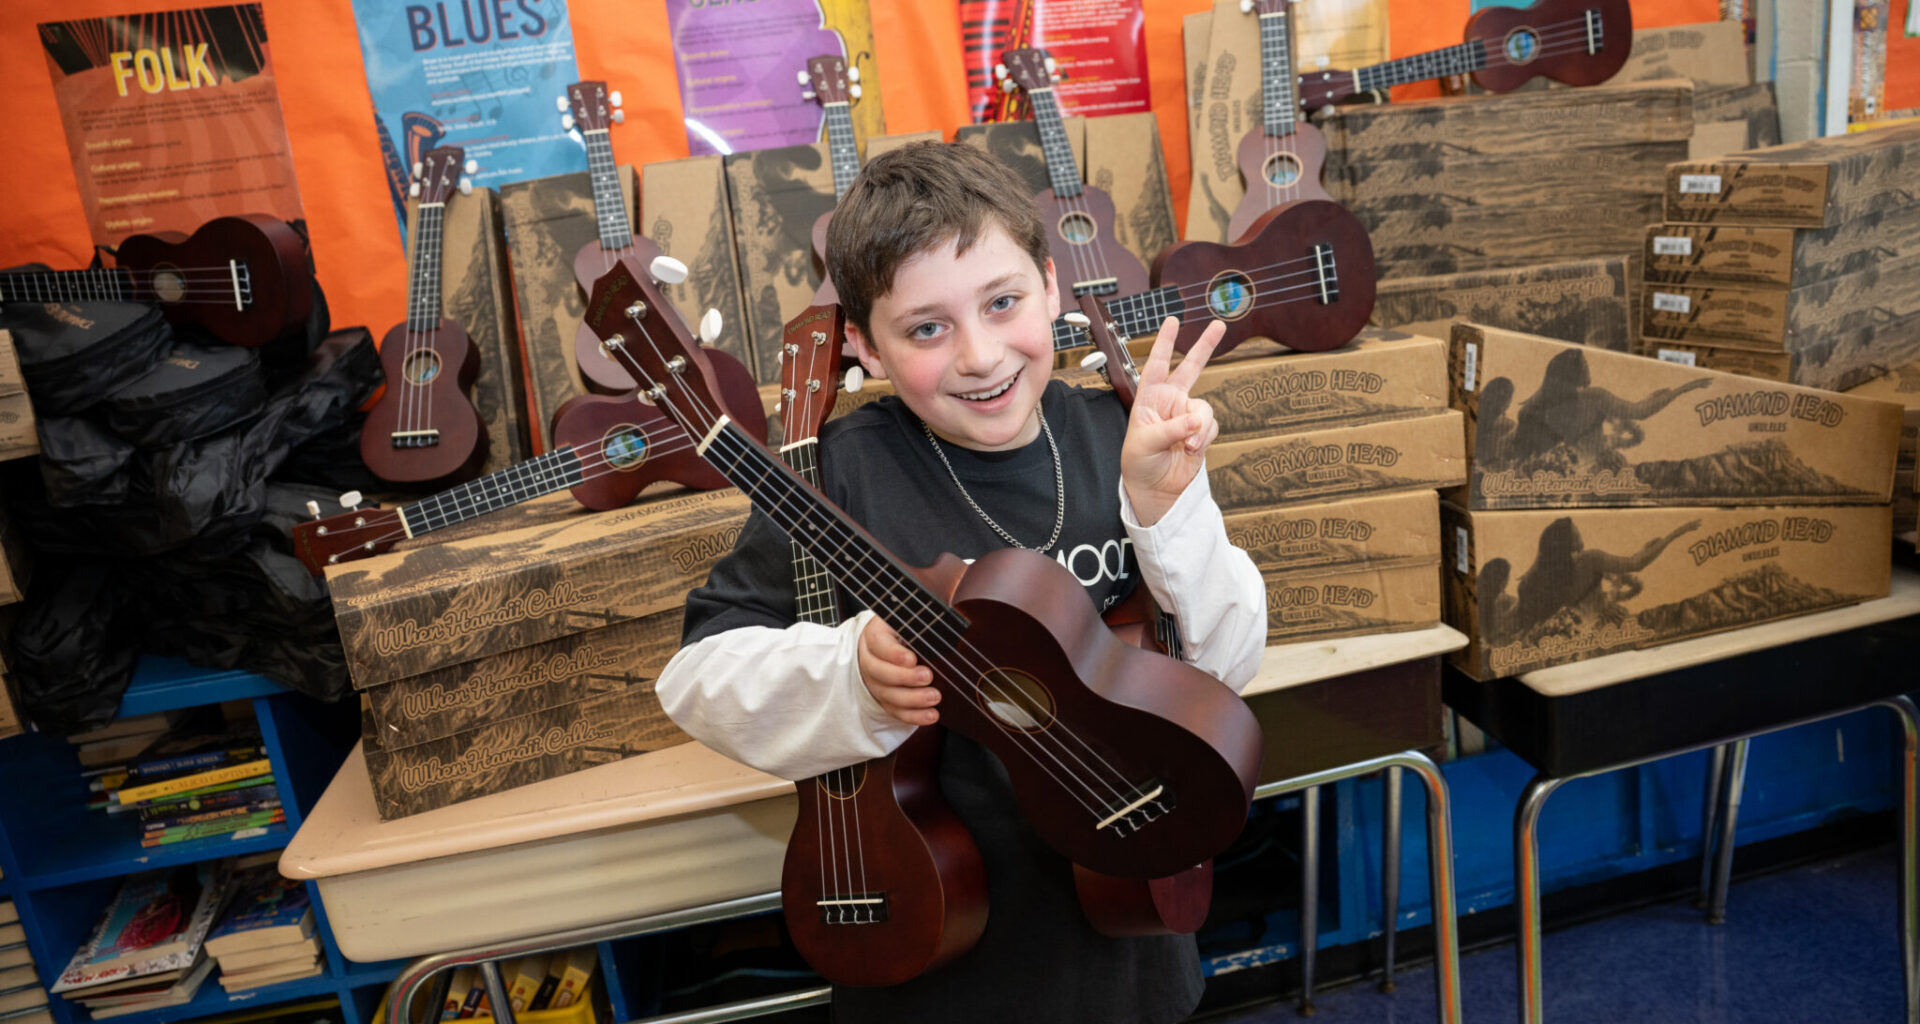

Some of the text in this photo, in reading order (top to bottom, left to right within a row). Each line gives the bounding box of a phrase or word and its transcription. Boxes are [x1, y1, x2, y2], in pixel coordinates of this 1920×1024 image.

[406, 0, 547, 51] BLUES
[110, 42, 218, 97] FOLK
[1236, 369, 1382, 409] DIAMOND HEAD
[1292, 394, 1330, 406] UKULELES
[1695, 391, 1844, 427] DIAMOND HEAD
[1748, 422, 1787, 432] UKULELES
[1253, 443, 1398, 483] DIAMOND HEAD
[1308, 469, 1346, 481] UKULELES
[1482, 470, 1532, 496] When
[1533, 470, 1593, 495] Hawaii
[672, 527, 743, 572] DIAMO
[1230, 518, 1372, 550] DIAMOND HEAD
[1281, 542, 1320, 554] UKULELES
[1688, 517, 1833, 566] DIAMOND HEAD
[1056, 537, 1133, 587] OOD
[1267, 584, 1374, 609] MOND HEAD
[1283, 608, 1321, 620] UKULELES
[376, 618, 443, 656] When
[444, 601, 525, 636] Hawaii
[1490, 641, 1539, 670] When
[1539, 634, 1599, 660] Hawaii
[403, 683, 470, 720] When
[469, 665, 548, 700] Hawaii
[402, 756, 466, 793] When
[466, 736, 544, 773] Hawaii
